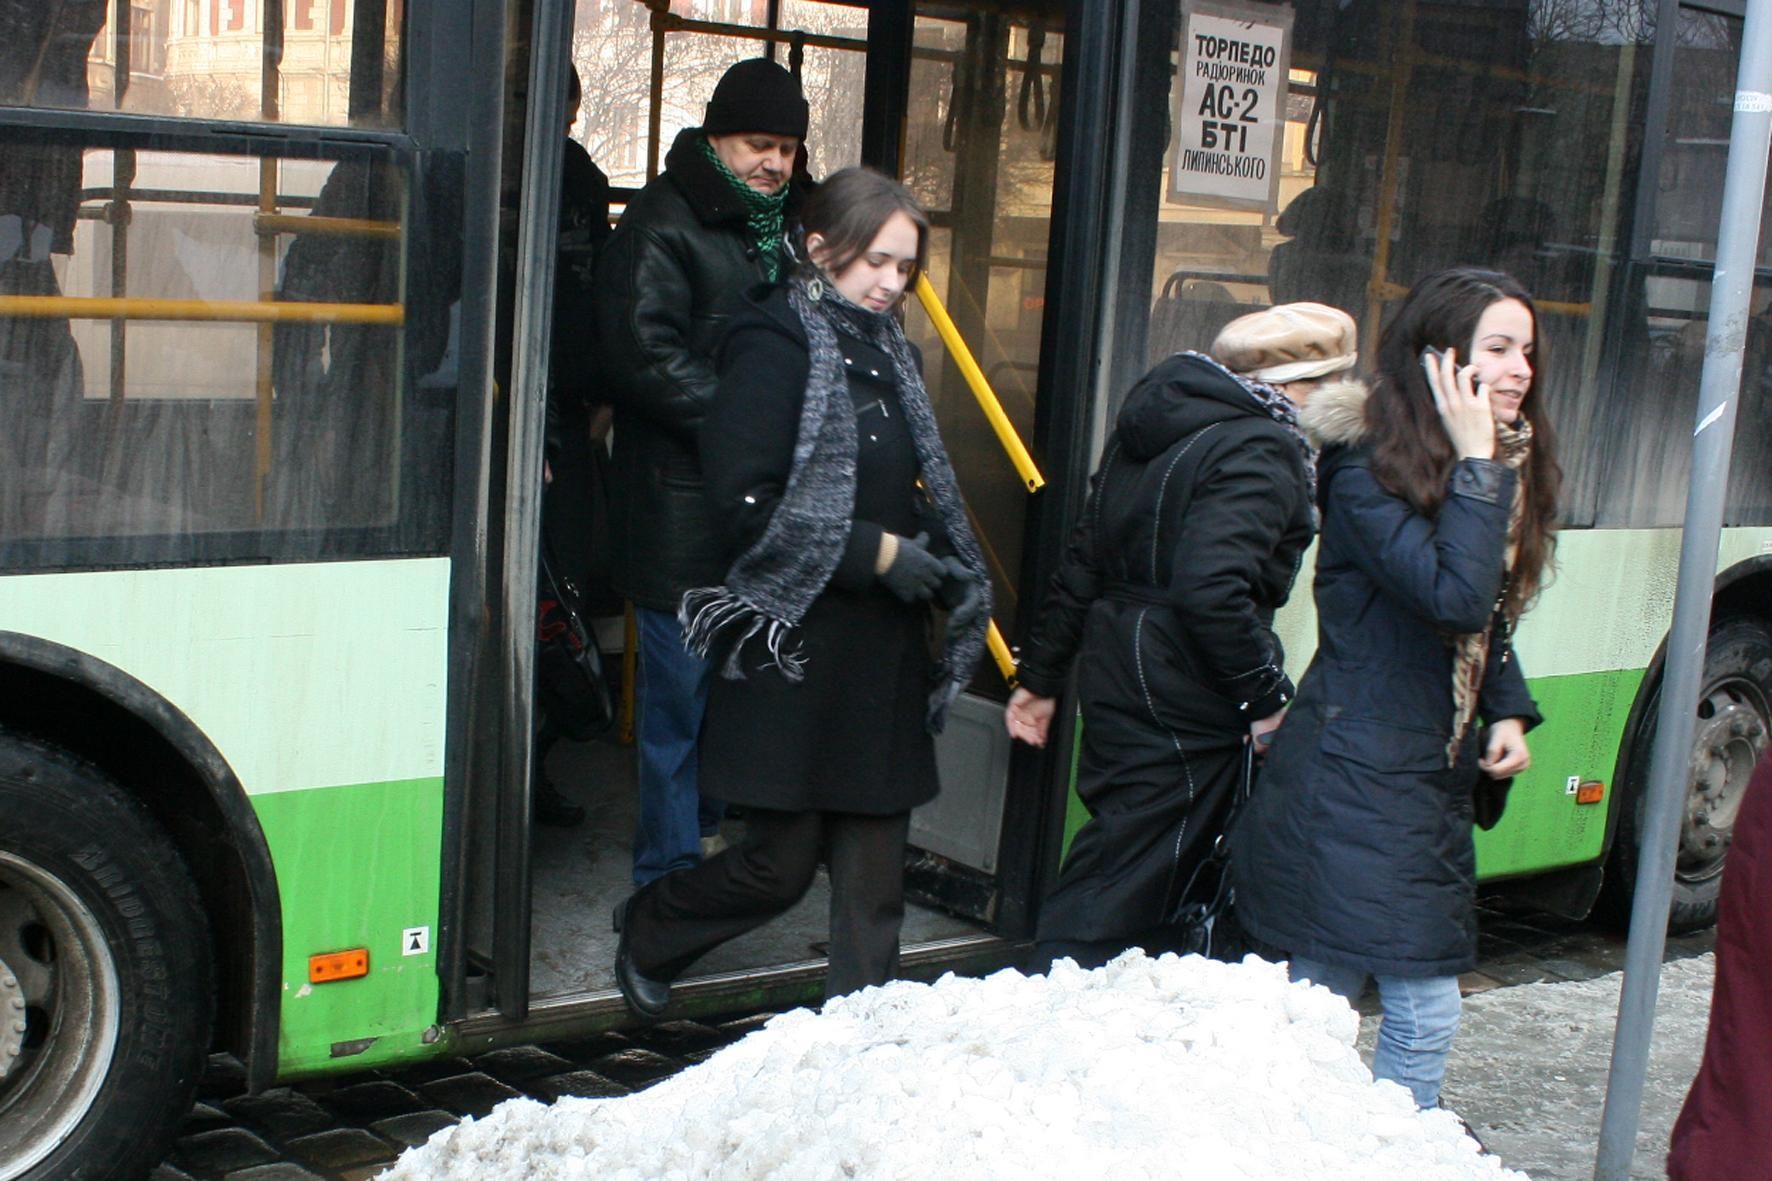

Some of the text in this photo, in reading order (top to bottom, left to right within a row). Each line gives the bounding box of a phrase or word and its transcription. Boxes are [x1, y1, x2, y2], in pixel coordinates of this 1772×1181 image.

[1195, 34, 1275, 67] ТОРПЕДО
[1198, 83, 1259, 123] АС-2
[1201, 120, 1247, 153] БТІ
[1183, 149, 1265, 180] ЛИПИНСЬКОГО
